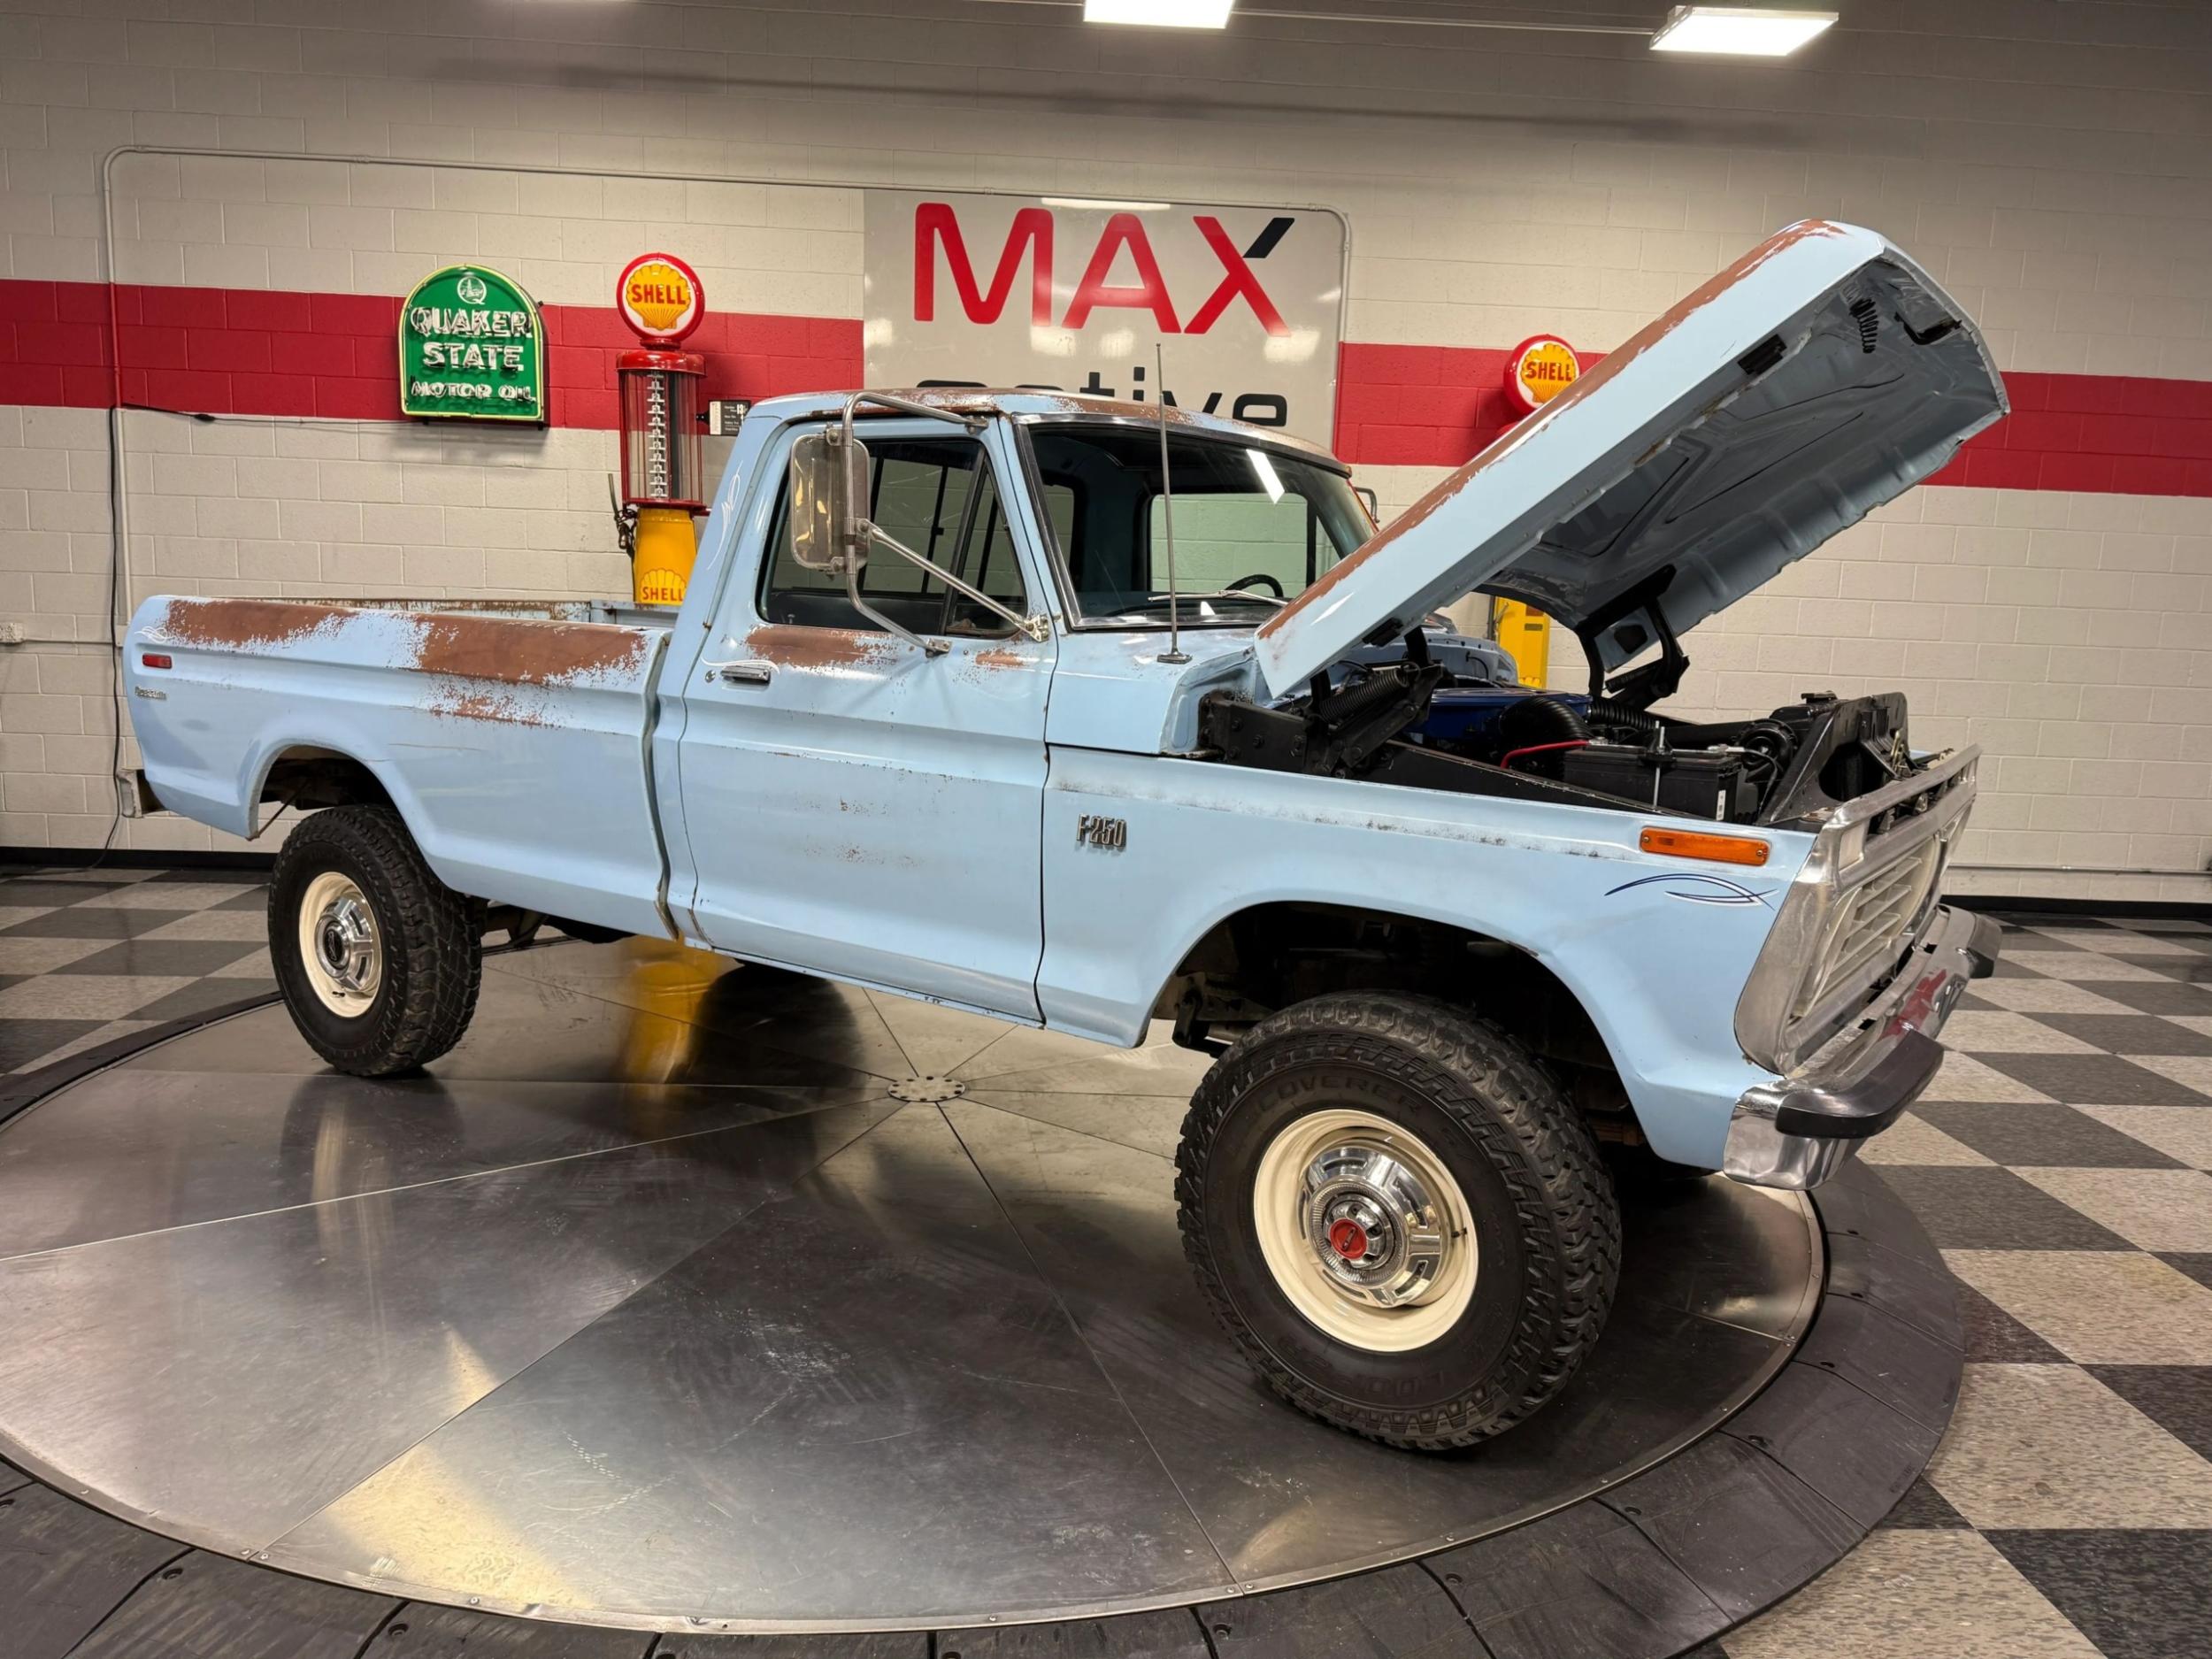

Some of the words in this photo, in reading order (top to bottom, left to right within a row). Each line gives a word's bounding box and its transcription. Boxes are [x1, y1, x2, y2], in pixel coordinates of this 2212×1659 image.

[914, 203, 1295, 337] MAX
[632, 284, 686, 304] SHELL
[411, 307, 533, 337] QUAKER
[423, 342, 524, 371] STATE
[1525, 361, 1572, 381] SHELL
[411, 380, 493, 399] MOTOR
[498, 384, 535, 401] OIL
[642, 587, 683, 602] SHELL
